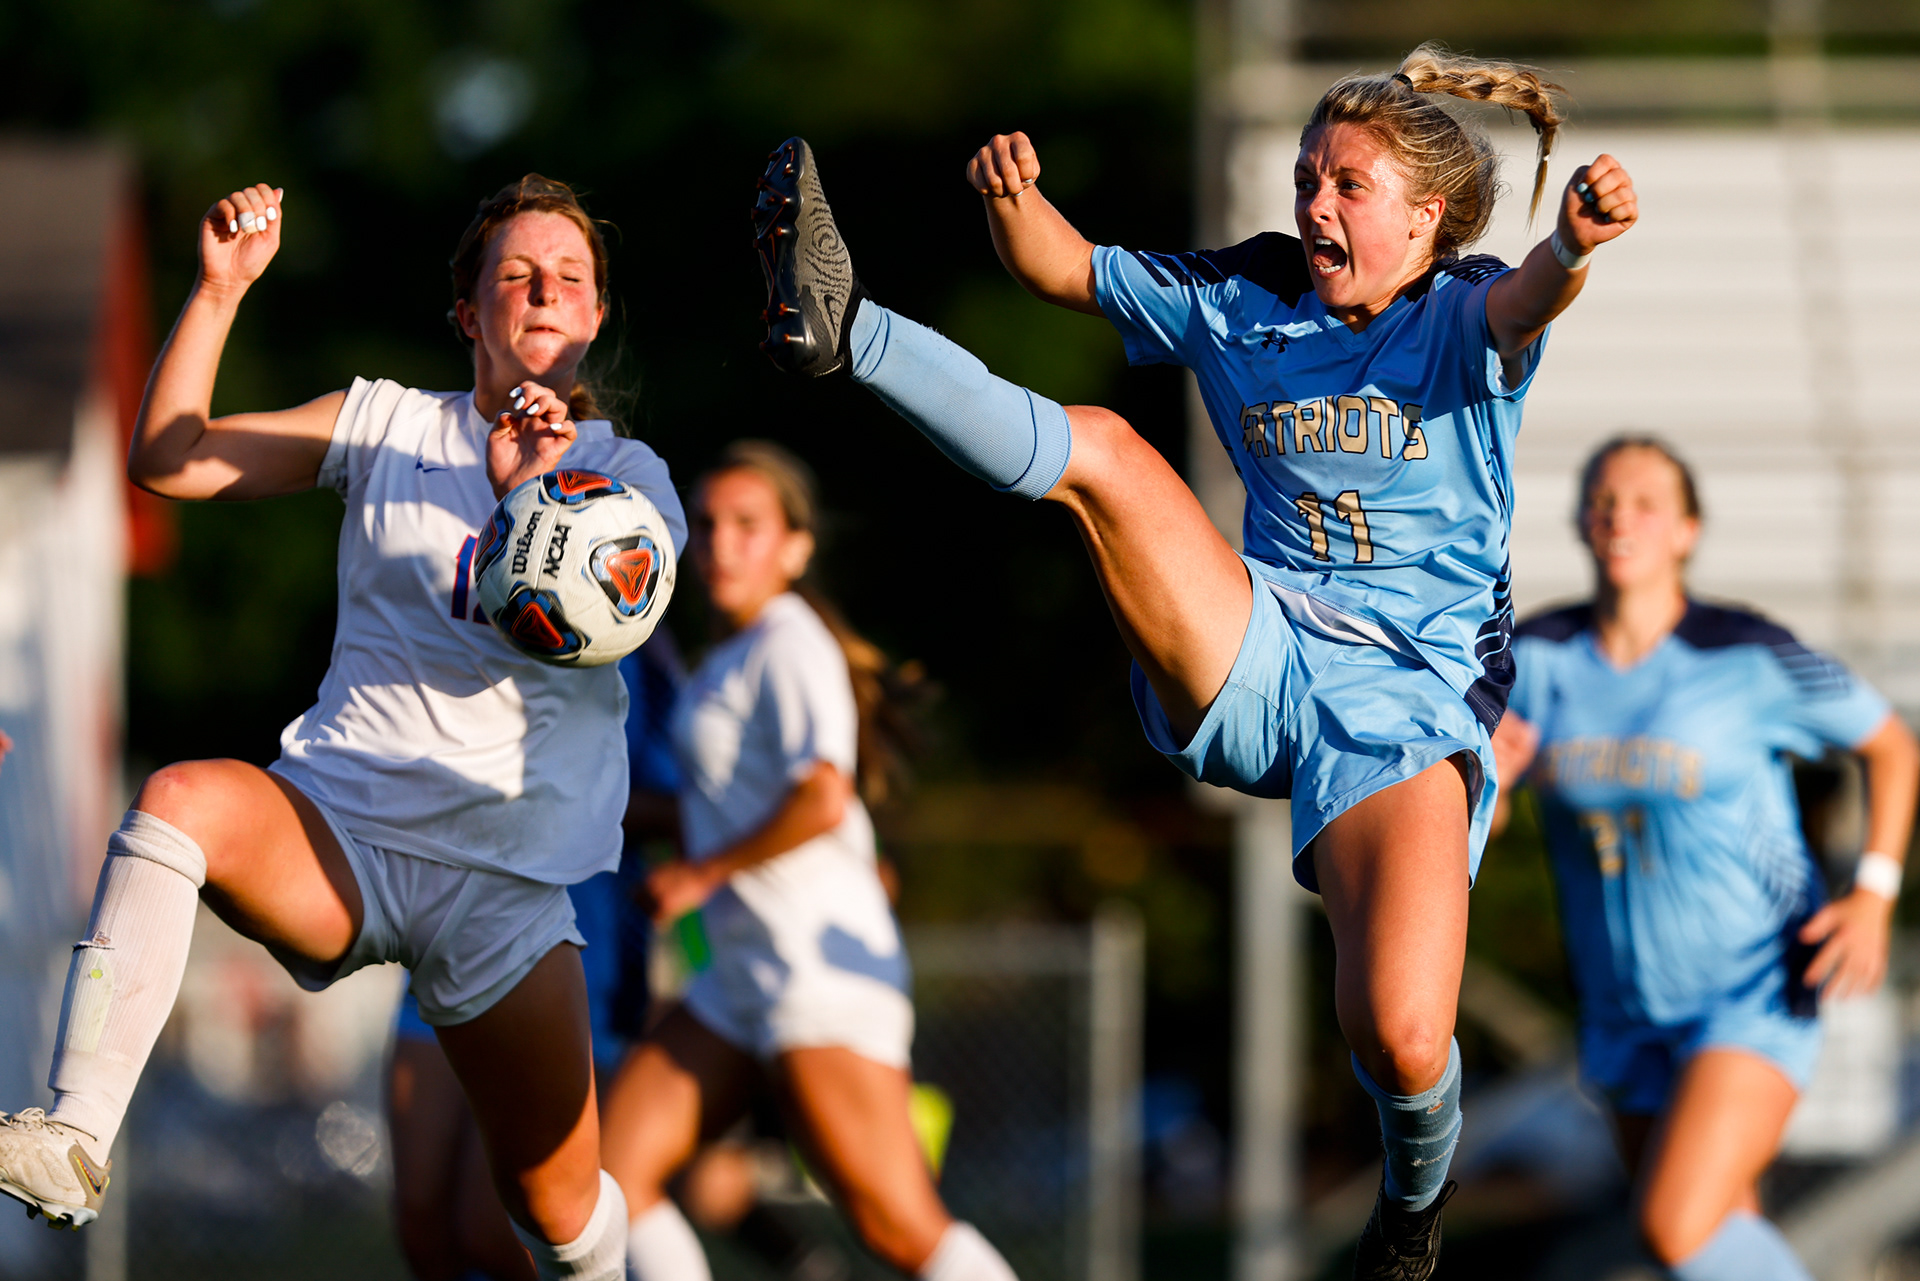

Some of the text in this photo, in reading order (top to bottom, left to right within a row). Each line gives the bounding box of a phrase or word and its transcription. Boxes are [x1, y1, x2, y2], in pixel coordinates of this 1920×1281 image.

[511, 510, 544, 575] Wilson
[543, 524, 571, 579] NCAA
[1294, 490, 1374, 563] 11
[451, 533, 491, 626] 1
